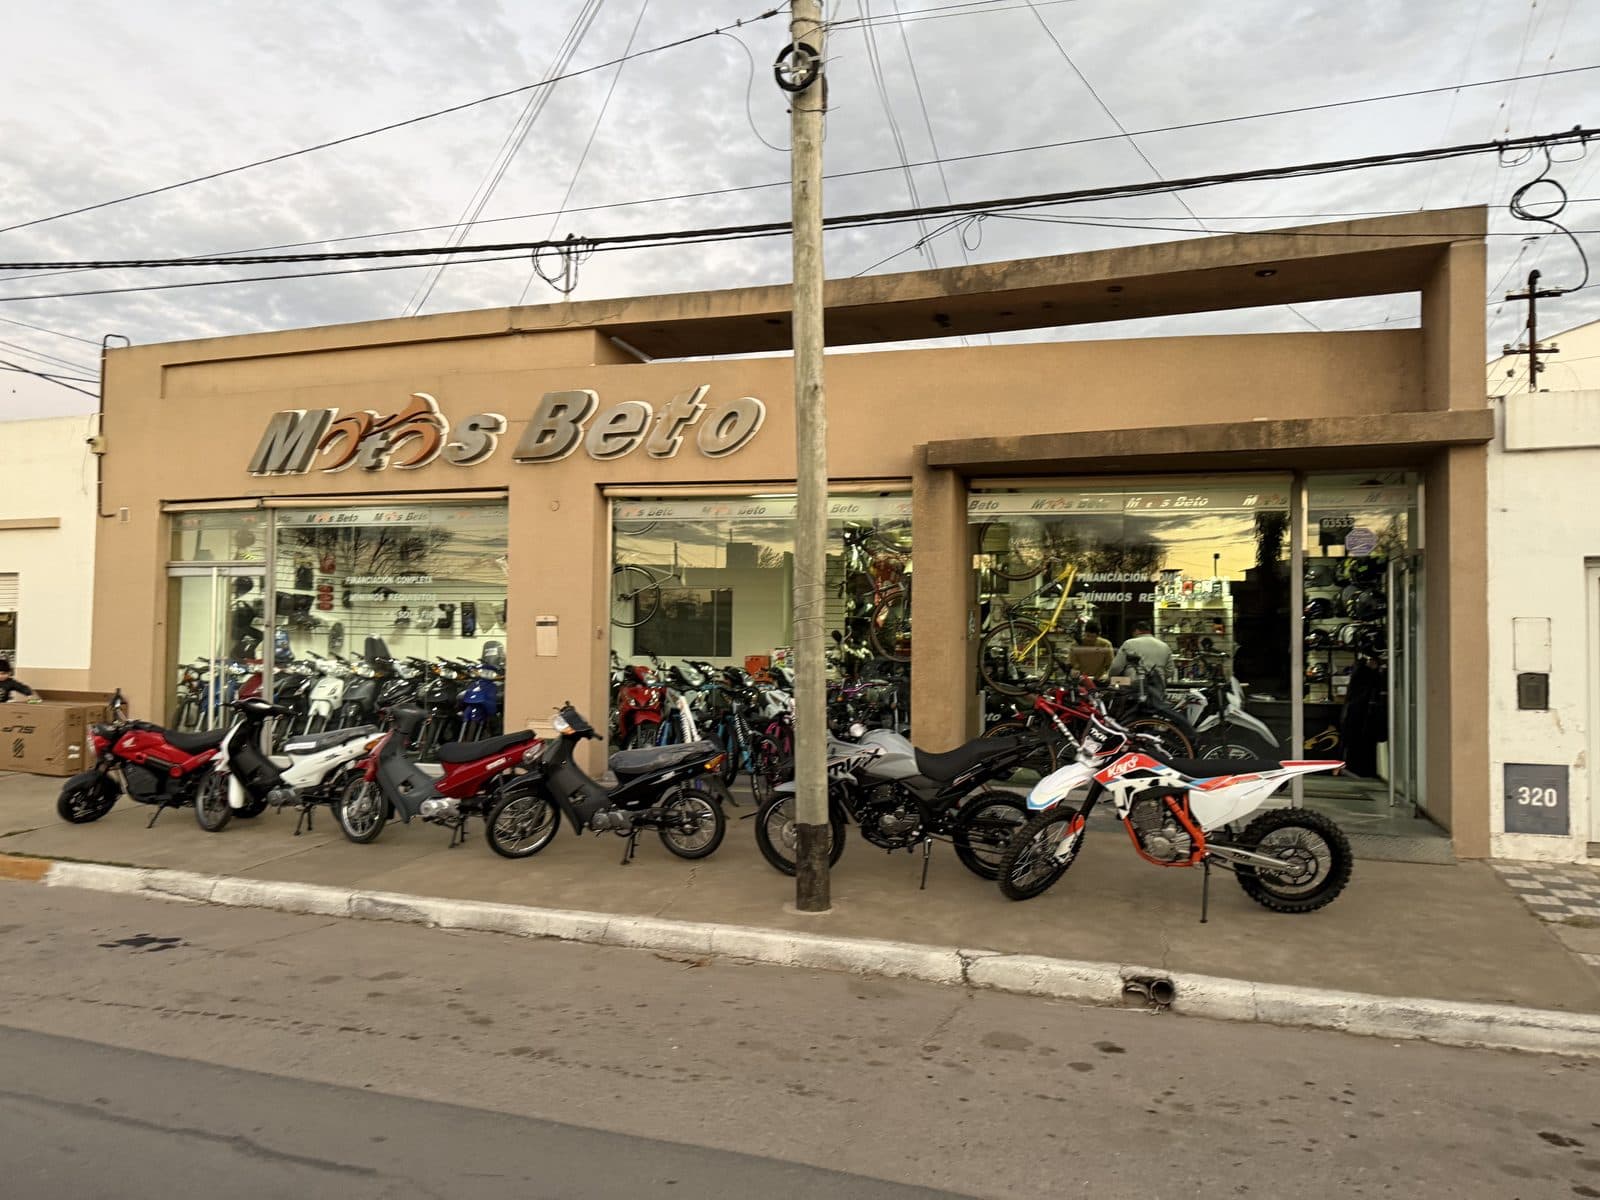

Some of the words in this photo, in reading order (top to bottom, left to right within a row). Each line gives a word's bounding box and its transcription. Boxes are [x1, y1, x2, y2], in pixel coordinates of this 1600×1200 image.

[248, 393, 508, 476] Motos
[511, 384, 767, 463] Beto
[1517, 786, 1557, 807] 320
